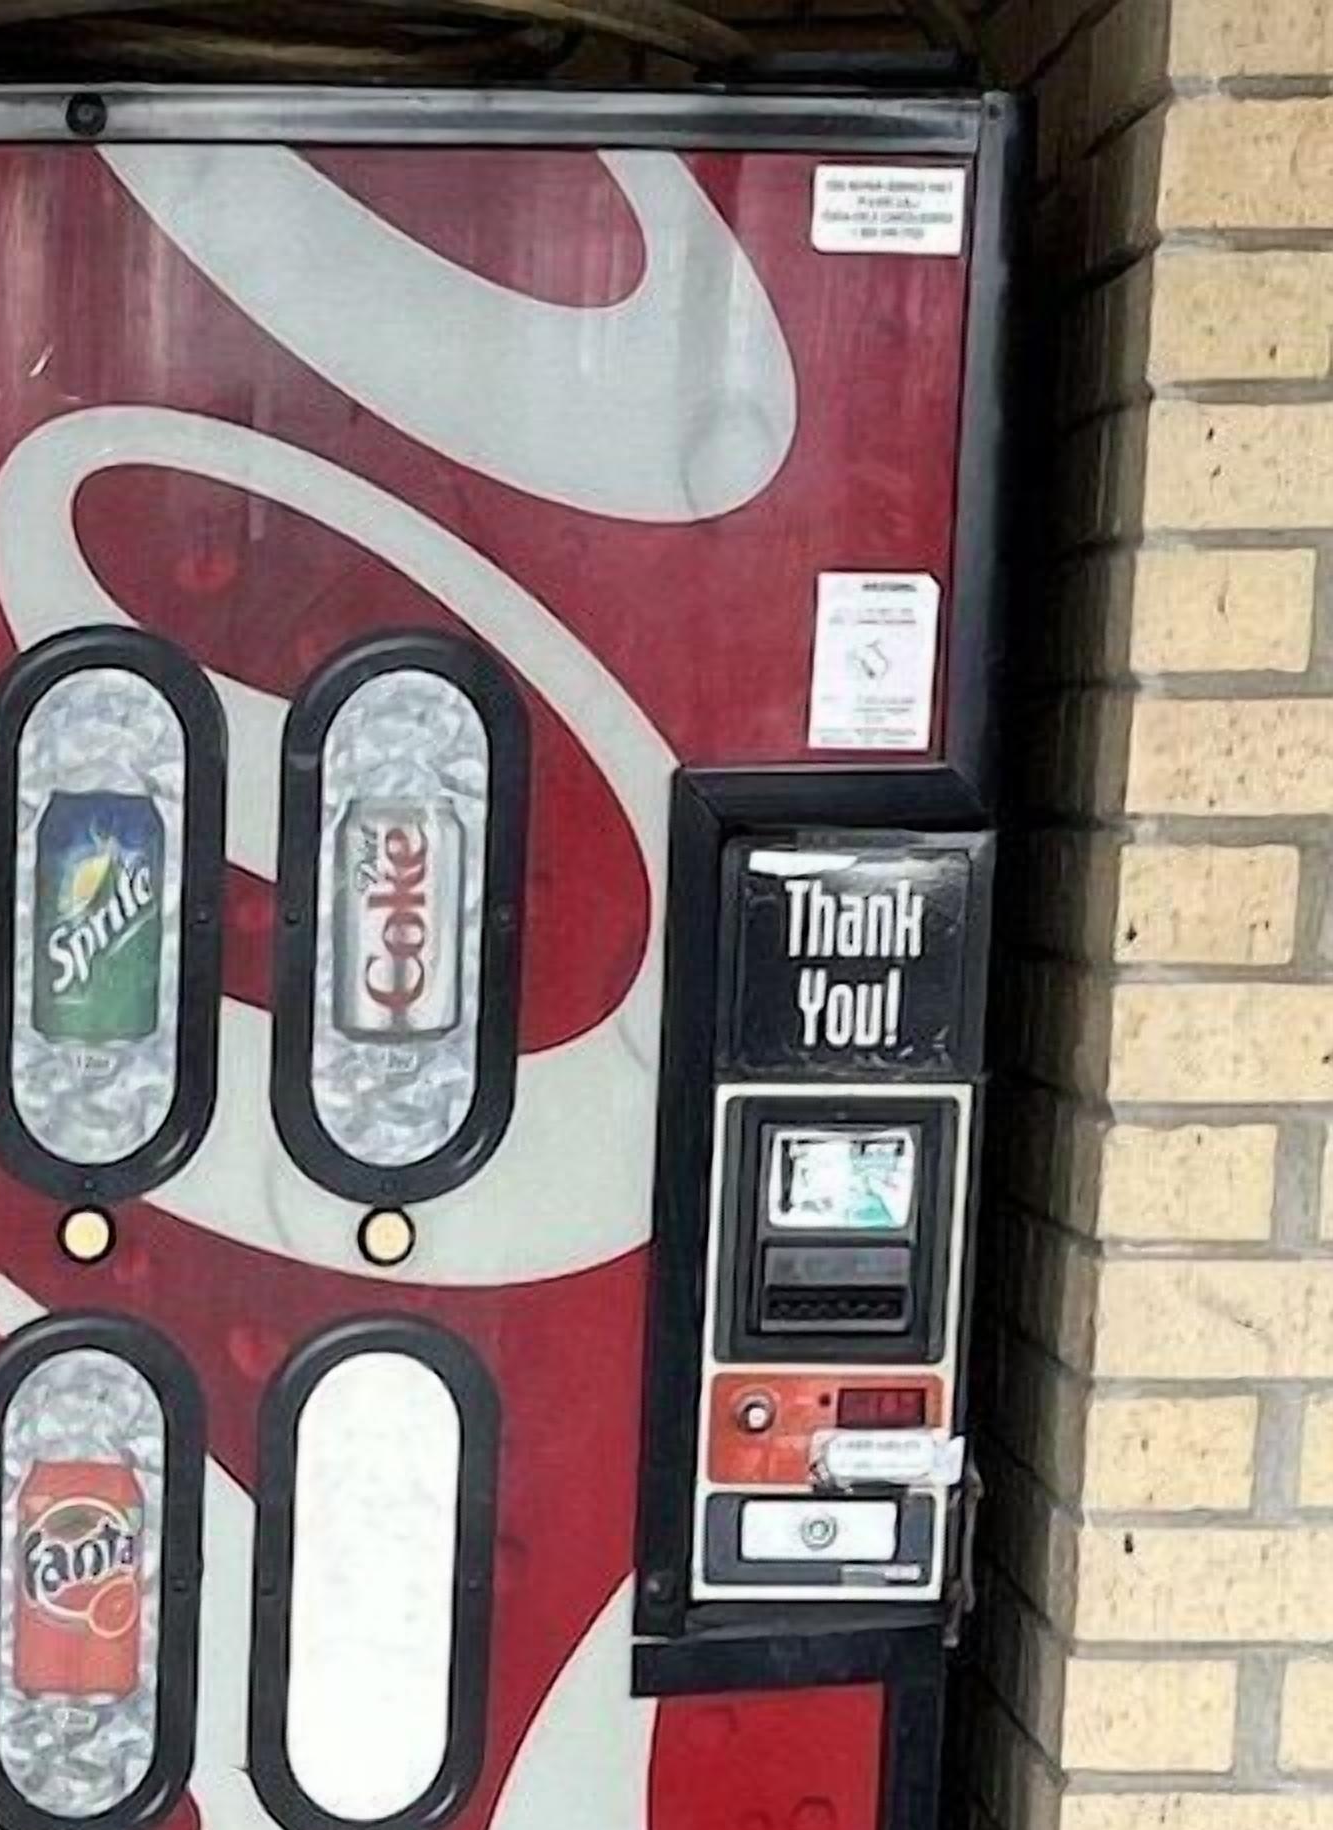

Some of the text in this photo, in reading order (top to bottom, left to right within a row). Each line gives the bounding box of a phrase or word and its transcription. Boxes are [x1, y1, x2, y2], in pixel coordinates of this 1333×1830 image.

[48, 850, 153, 993] Sprite
[365, 826, 428, 1008] Coke
[784, 878, 925, 958] Thank
[797, 967, 902, 1048] You!
[25, 1522, 139, 1602] Fanta
